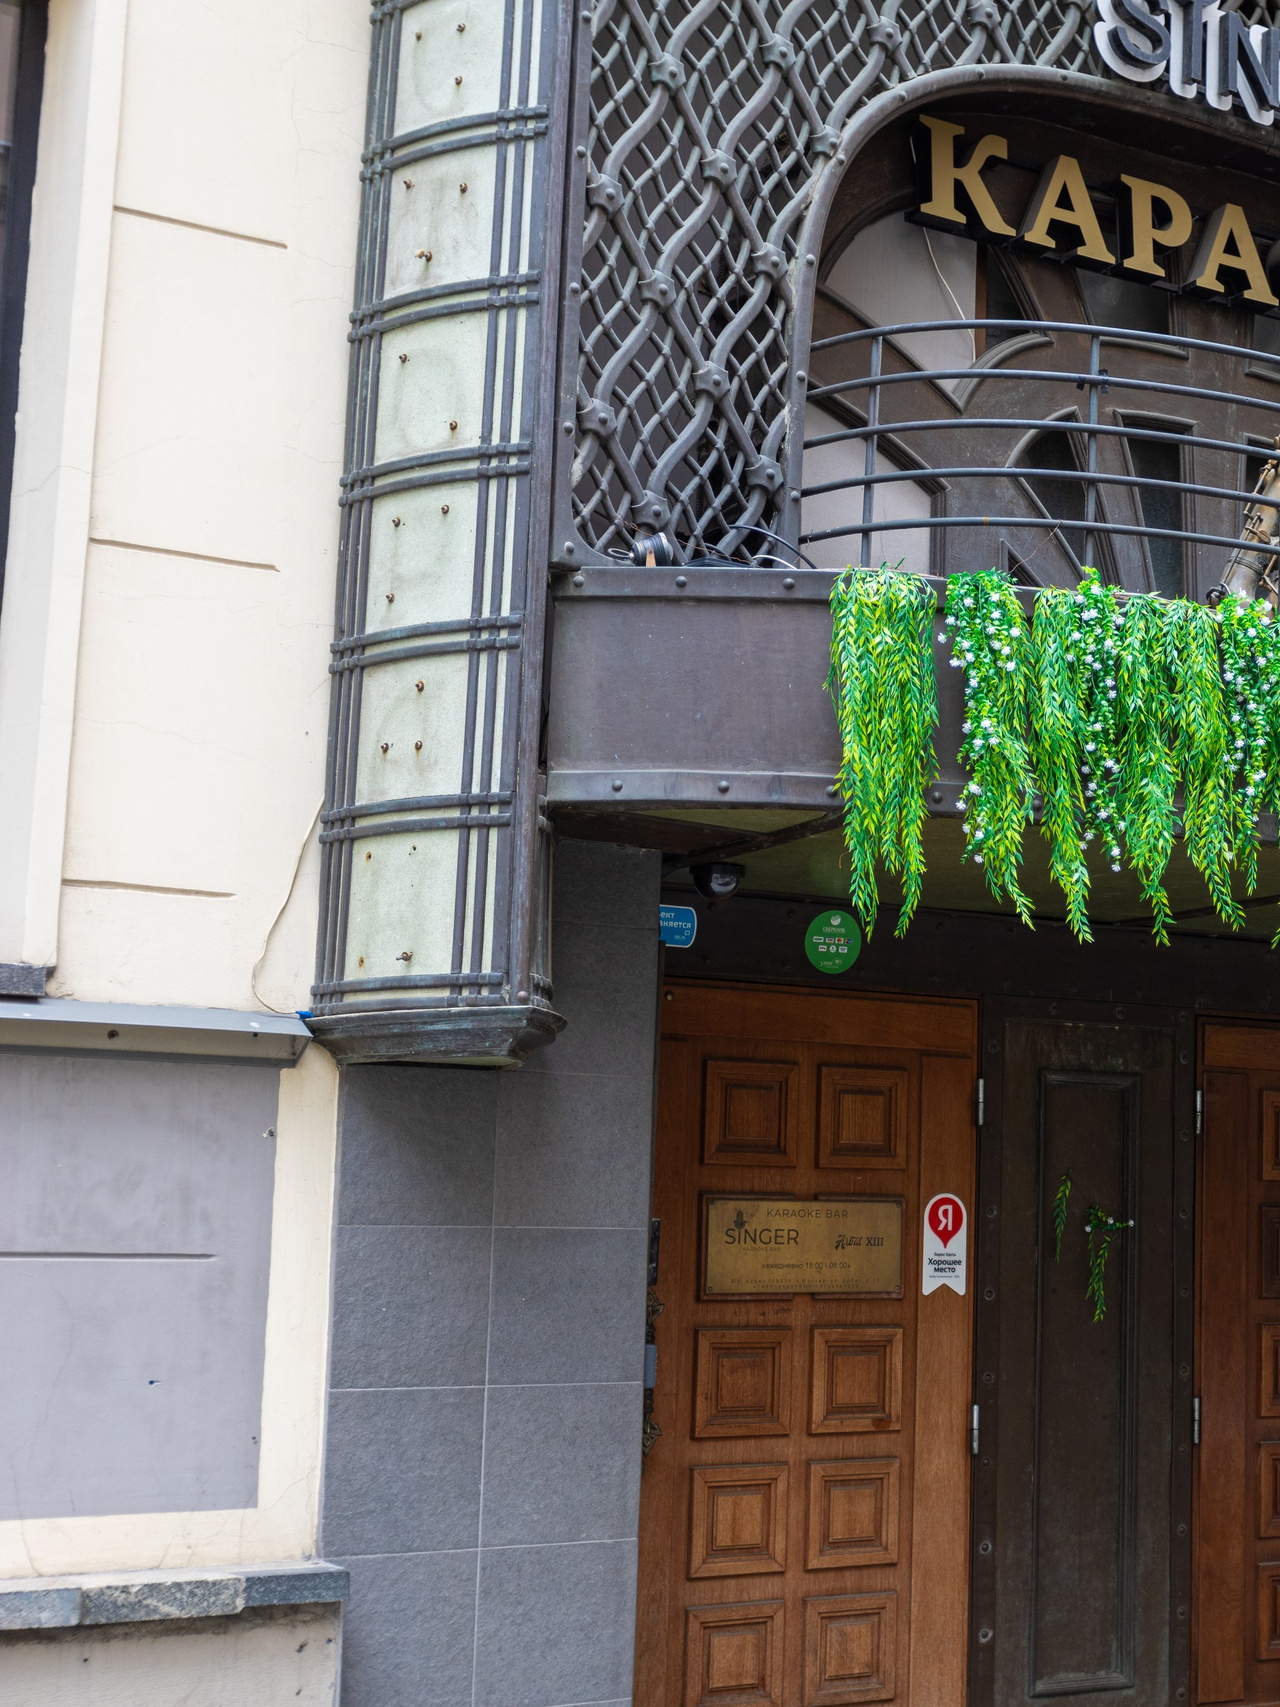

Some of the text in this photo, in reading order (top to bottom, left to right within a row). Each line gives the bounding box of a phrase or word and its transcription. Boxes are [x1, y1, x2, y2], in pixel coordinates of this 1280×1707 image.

[659, 911, 675, 919] ект
[766, 1209, 848, 1219] KARAOKE BAR
[938, 1204, 953, 1231] Я
[725, 1228, 799, 1245] SINGER
[835, 1234, 884, 1250] Arbat XIII
[928, 1258, 962, 1267] Хорошее
